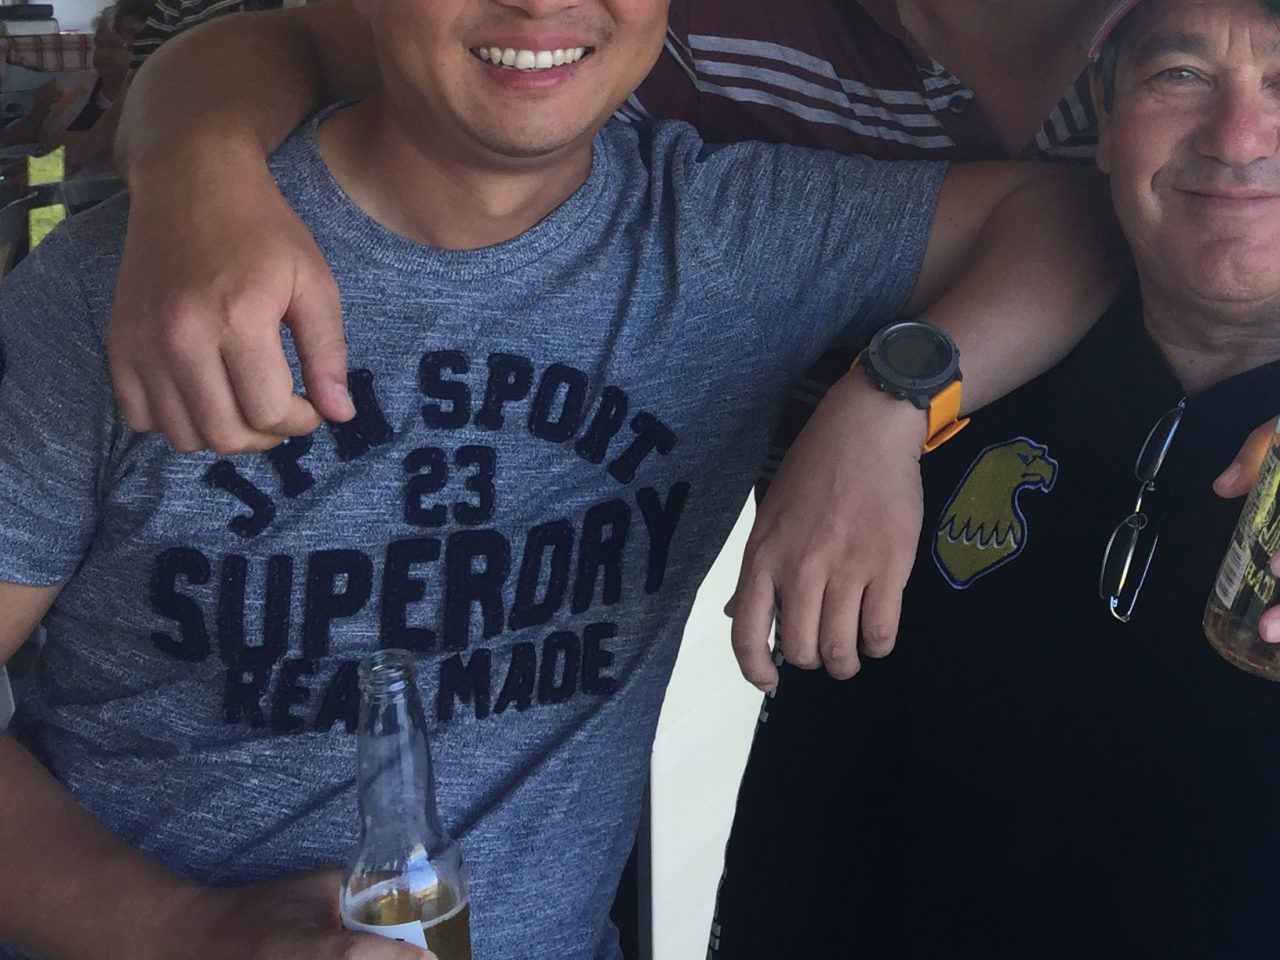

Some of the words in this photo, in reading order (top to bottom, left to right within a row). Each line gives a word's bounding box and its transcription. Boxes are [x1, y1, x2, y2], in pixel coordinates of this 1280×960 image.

[419, 350, 678, 485] SPORT
[403, 445, 497, 528] 23
[150, 480, 692, 665] SUPERDRY
[436, 623, 618, 723] MADE
